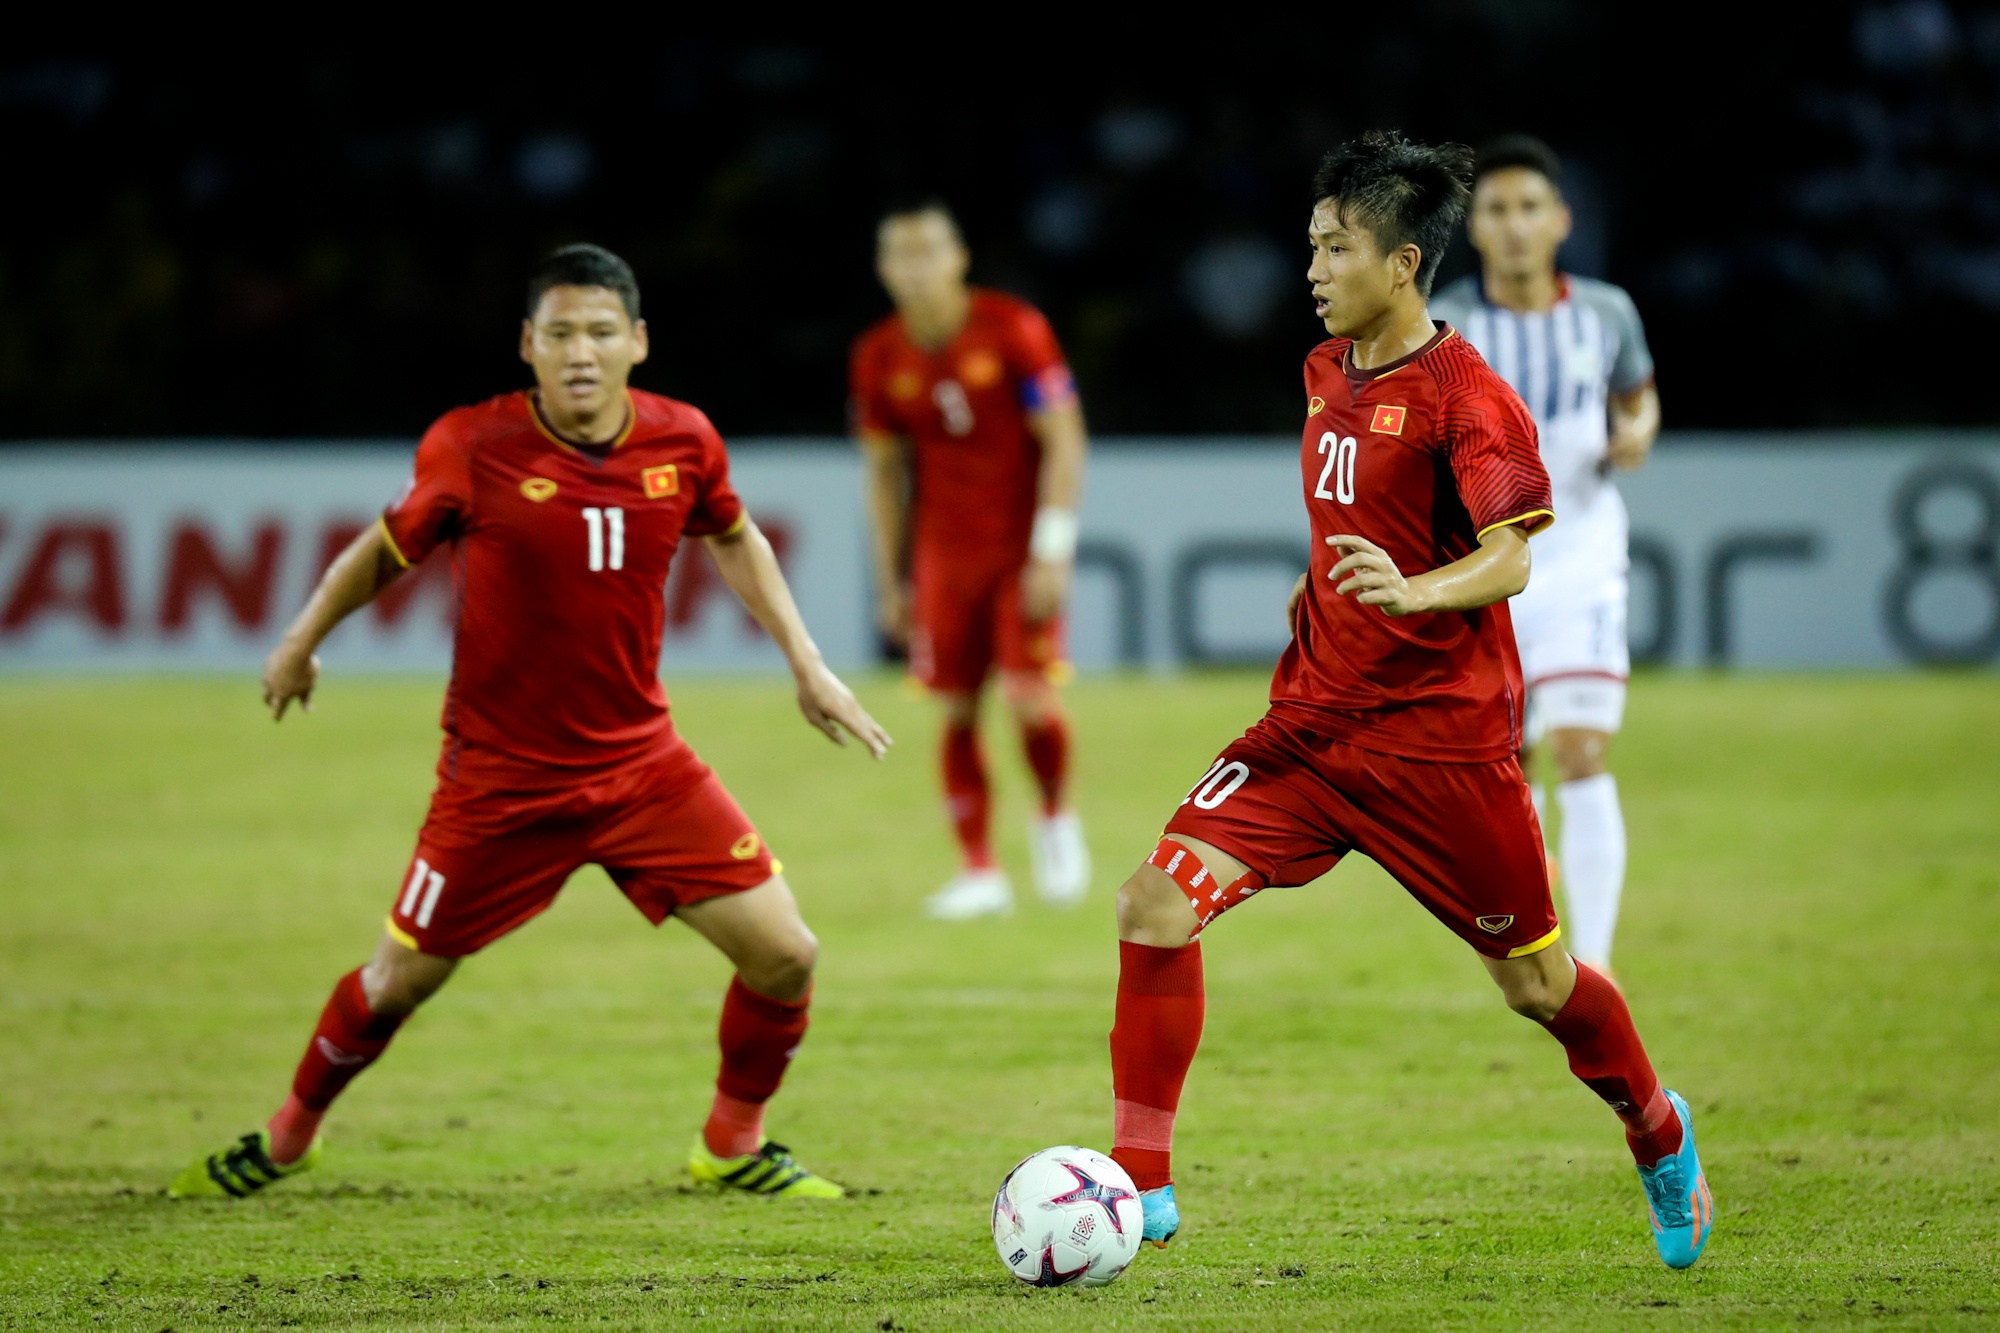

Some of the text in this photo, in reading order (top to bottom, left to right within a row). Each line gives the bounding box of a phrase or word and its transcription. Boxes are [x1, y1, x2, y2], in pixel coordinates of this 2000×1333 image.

[1314, 431, 1357, 505] 20
[582, 506, 625, 572] 11
[400, 858, 446, 930] 11
